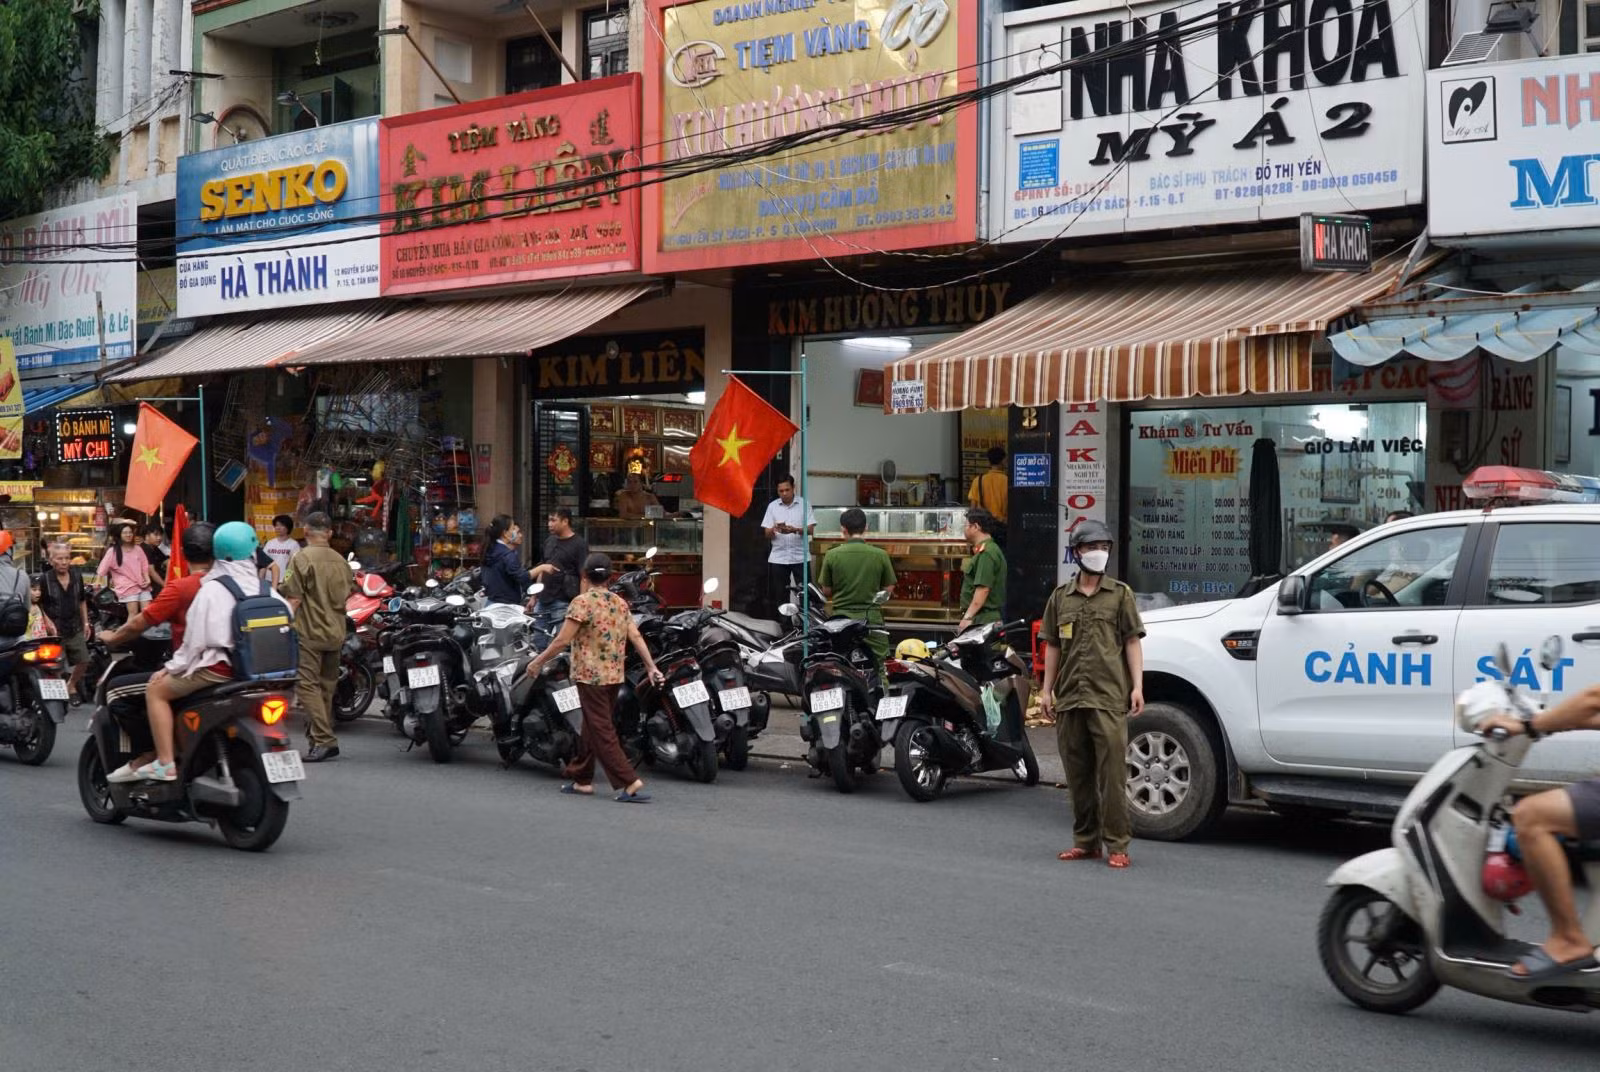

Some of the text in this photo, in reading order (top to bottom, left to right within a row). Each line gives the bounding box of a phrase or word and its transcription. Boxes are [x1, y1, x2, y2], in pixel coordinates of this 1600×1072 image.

[733, 17, 871, 73] TIỆM VÀNG
[1070, 0, 1400, 120] NHA KHOA
[448, 110, 560, 154] TIỆM VÀNG
[1089, 111, 1217, 166] MỸ
[1233, 97, 1296, 149] Á
[1320, 101, 1373, 139] 2
[1275, 164, 1294, 182] THỊ
[1298, 155, 1321, 177] YẾN
[199, 160, 348, 223] SENKO
[23, 215, 86, 262] BÁNH
[256, 216, 276, 230] CHO
[1315, 223, 1368, 262] NHA KHOA
[188, 276, 199, 288] GIA
[220, 250, 329, 300] HÀ THÀNH
[538, 339, 706, 388] KIM LIÊN
[1490, 368, 1534, 412] RĂNG
[72, 416, 98, 436] BÁNH
[100, 415, 110, 435] MÌ
[1021, 406, 1039, 430] 8
[1138, 420, 1254, 440] Khám & Tư Vấn
[64, 438, 109, 460] MỸ CHI
[1172, 447, 1236, 475] Miễn Phí
[1304, 436, 1424, 457] GIỜ LÀM VIỆC
[1304, 642, 1575, 692] CẢNH SÁT
